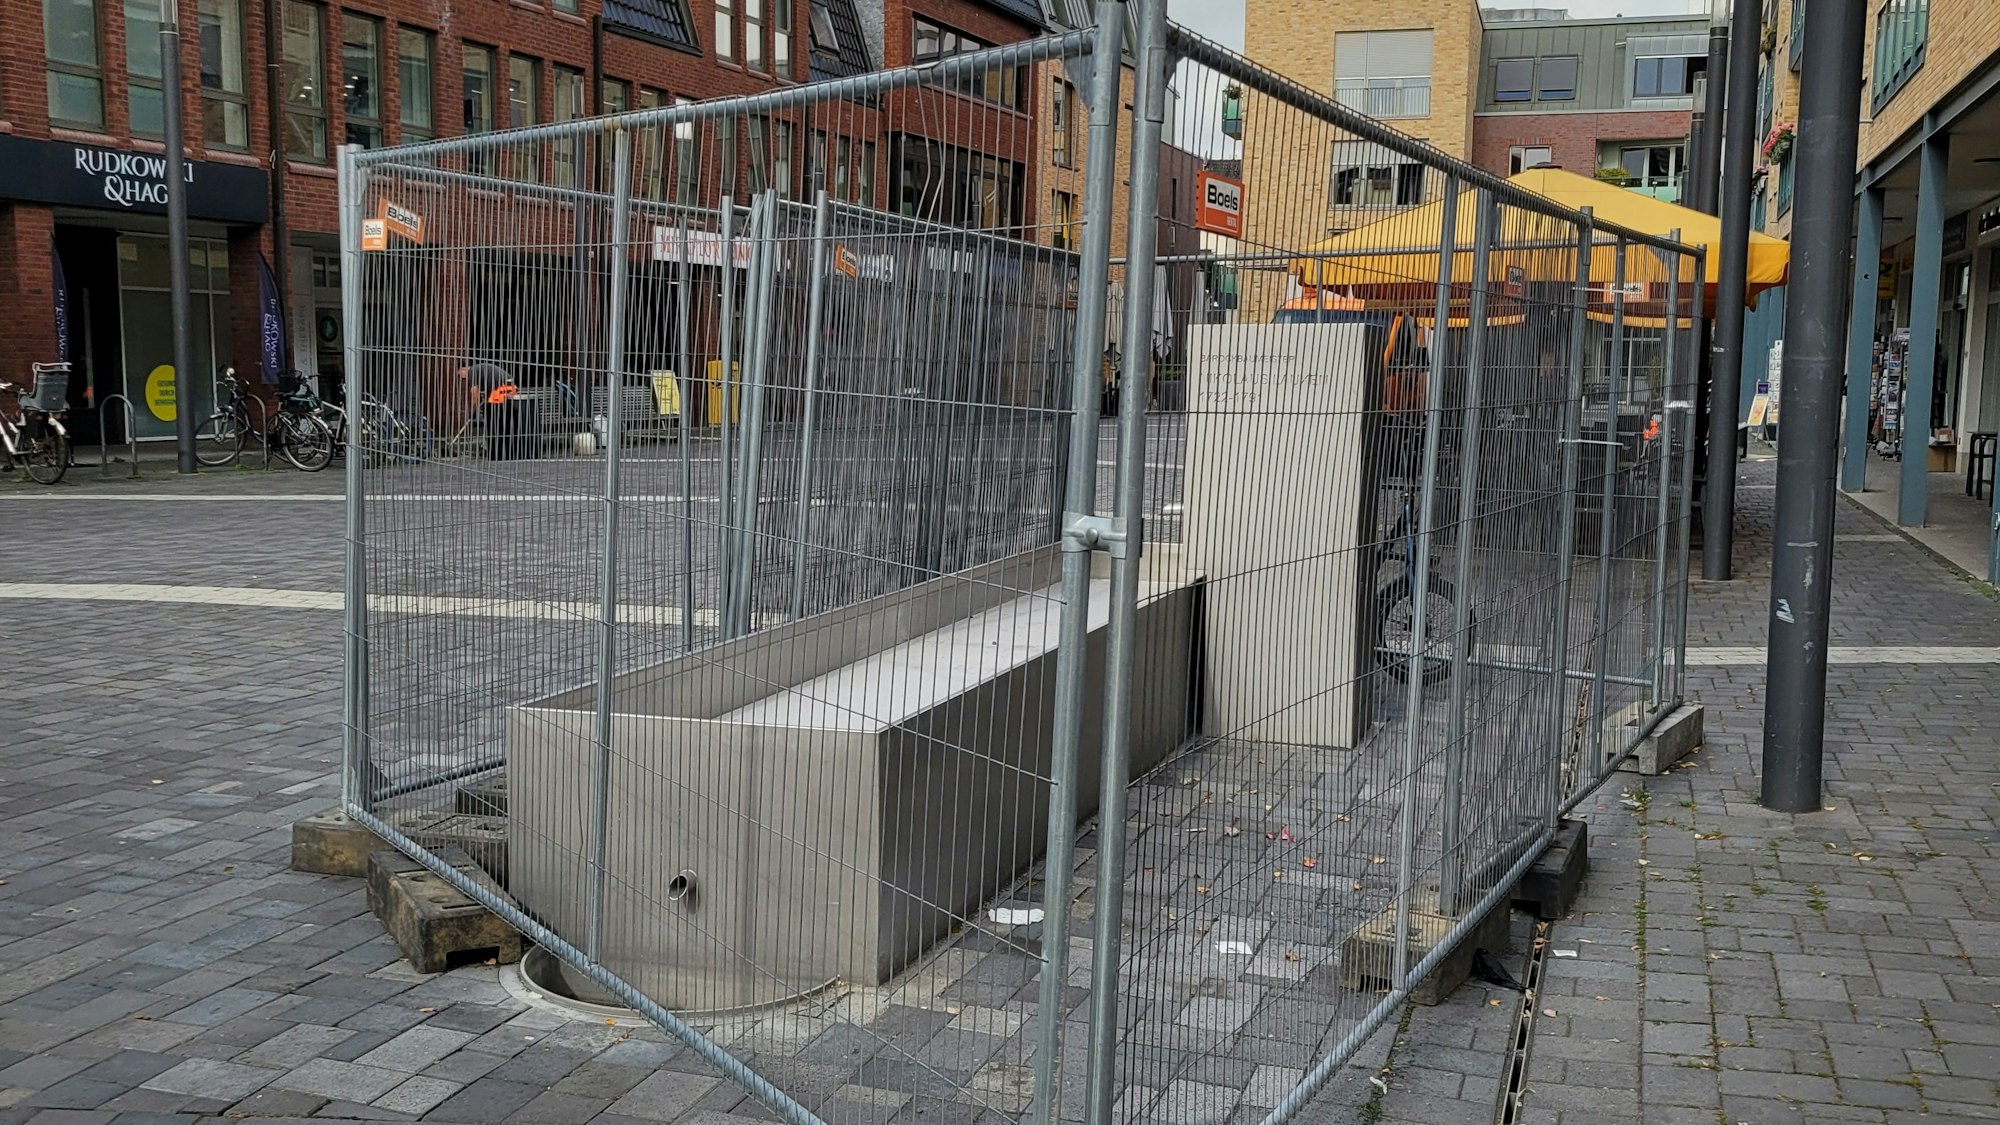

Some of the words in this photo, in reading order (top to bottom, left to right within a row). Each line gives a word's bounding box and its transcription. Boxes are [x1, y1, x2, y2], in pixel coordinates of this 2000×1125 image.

[75, 148, 194, 182] RUDKOWI
[1207, 184, 1238, 211] Boels
[388, 206, 418, 229] Boels
